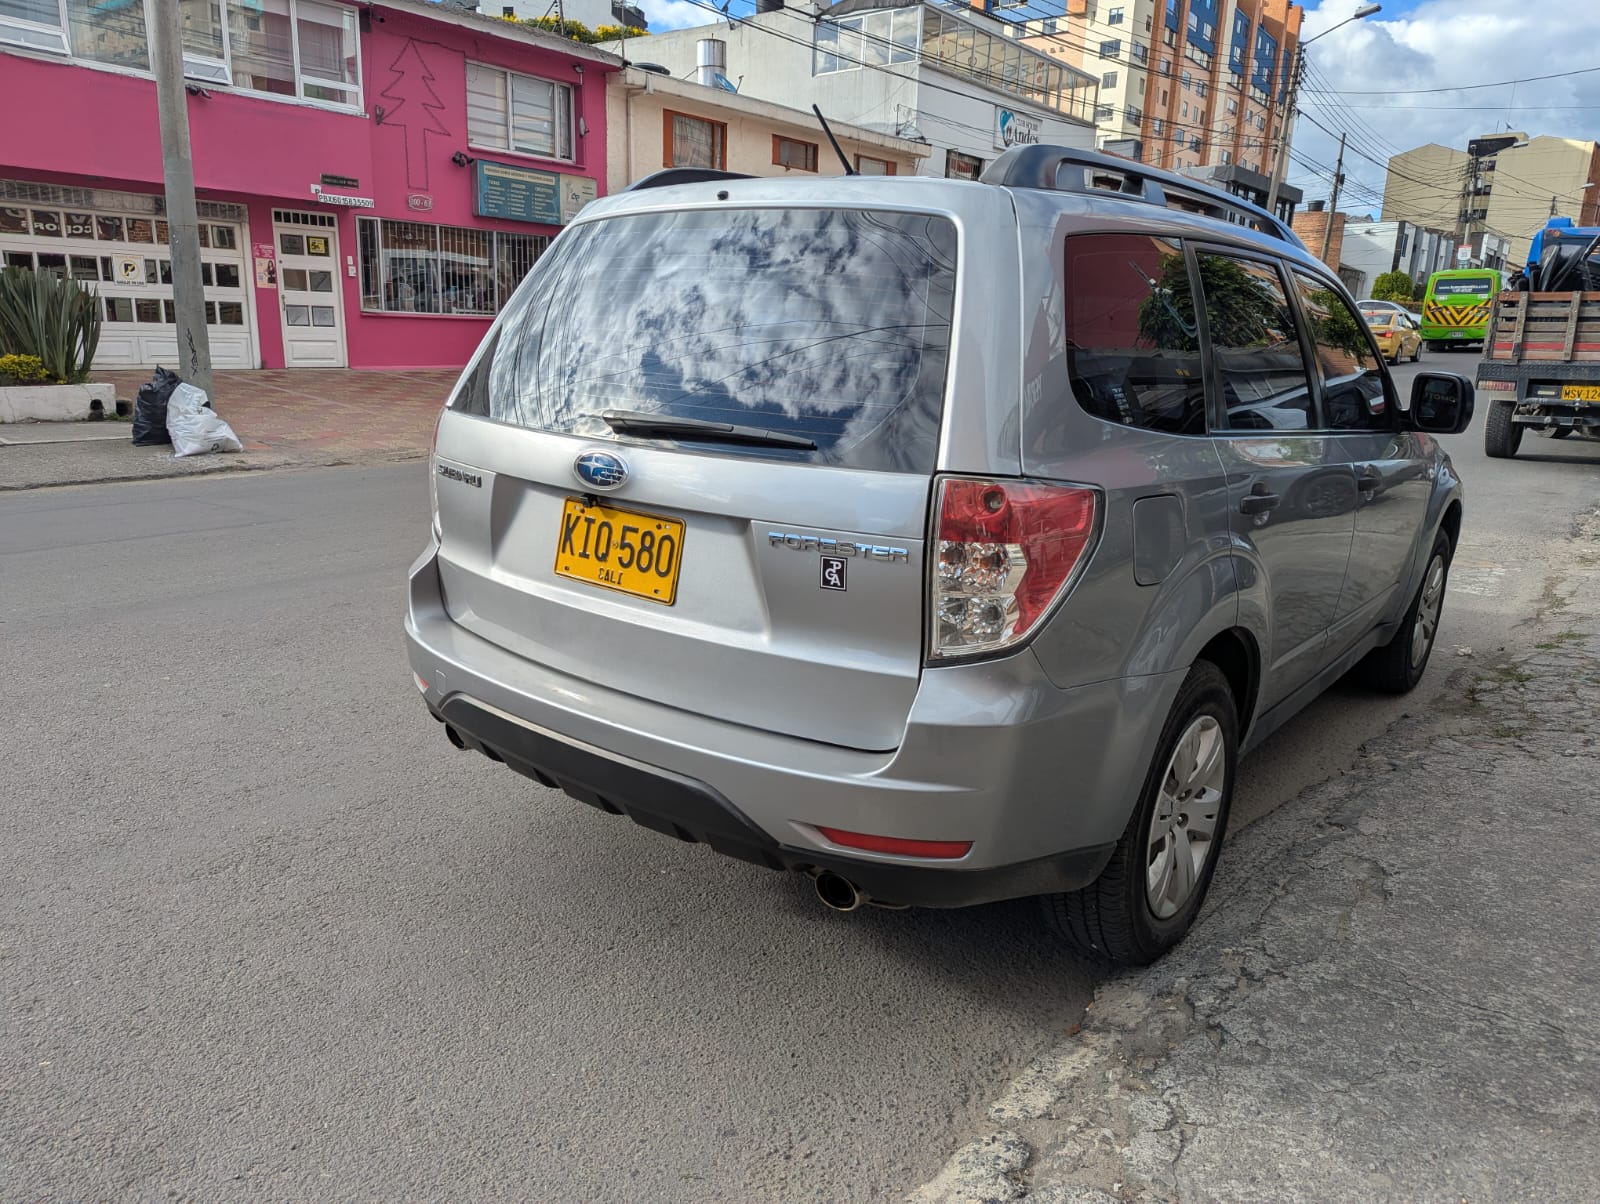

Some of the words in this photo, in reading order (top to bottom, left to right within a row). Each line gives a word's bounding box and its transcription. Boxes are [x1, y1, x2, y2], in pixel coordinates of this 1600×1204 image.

[1564, 389, 1583, 399] MSV
[438, 464, 482, 488] SUBARU
[561, 513, 613, 563] KIQ
[617, 525, 676, 578] 580
[768, 531, 909, 564] FORESTER
[598, 567, 623, 586] CALI
